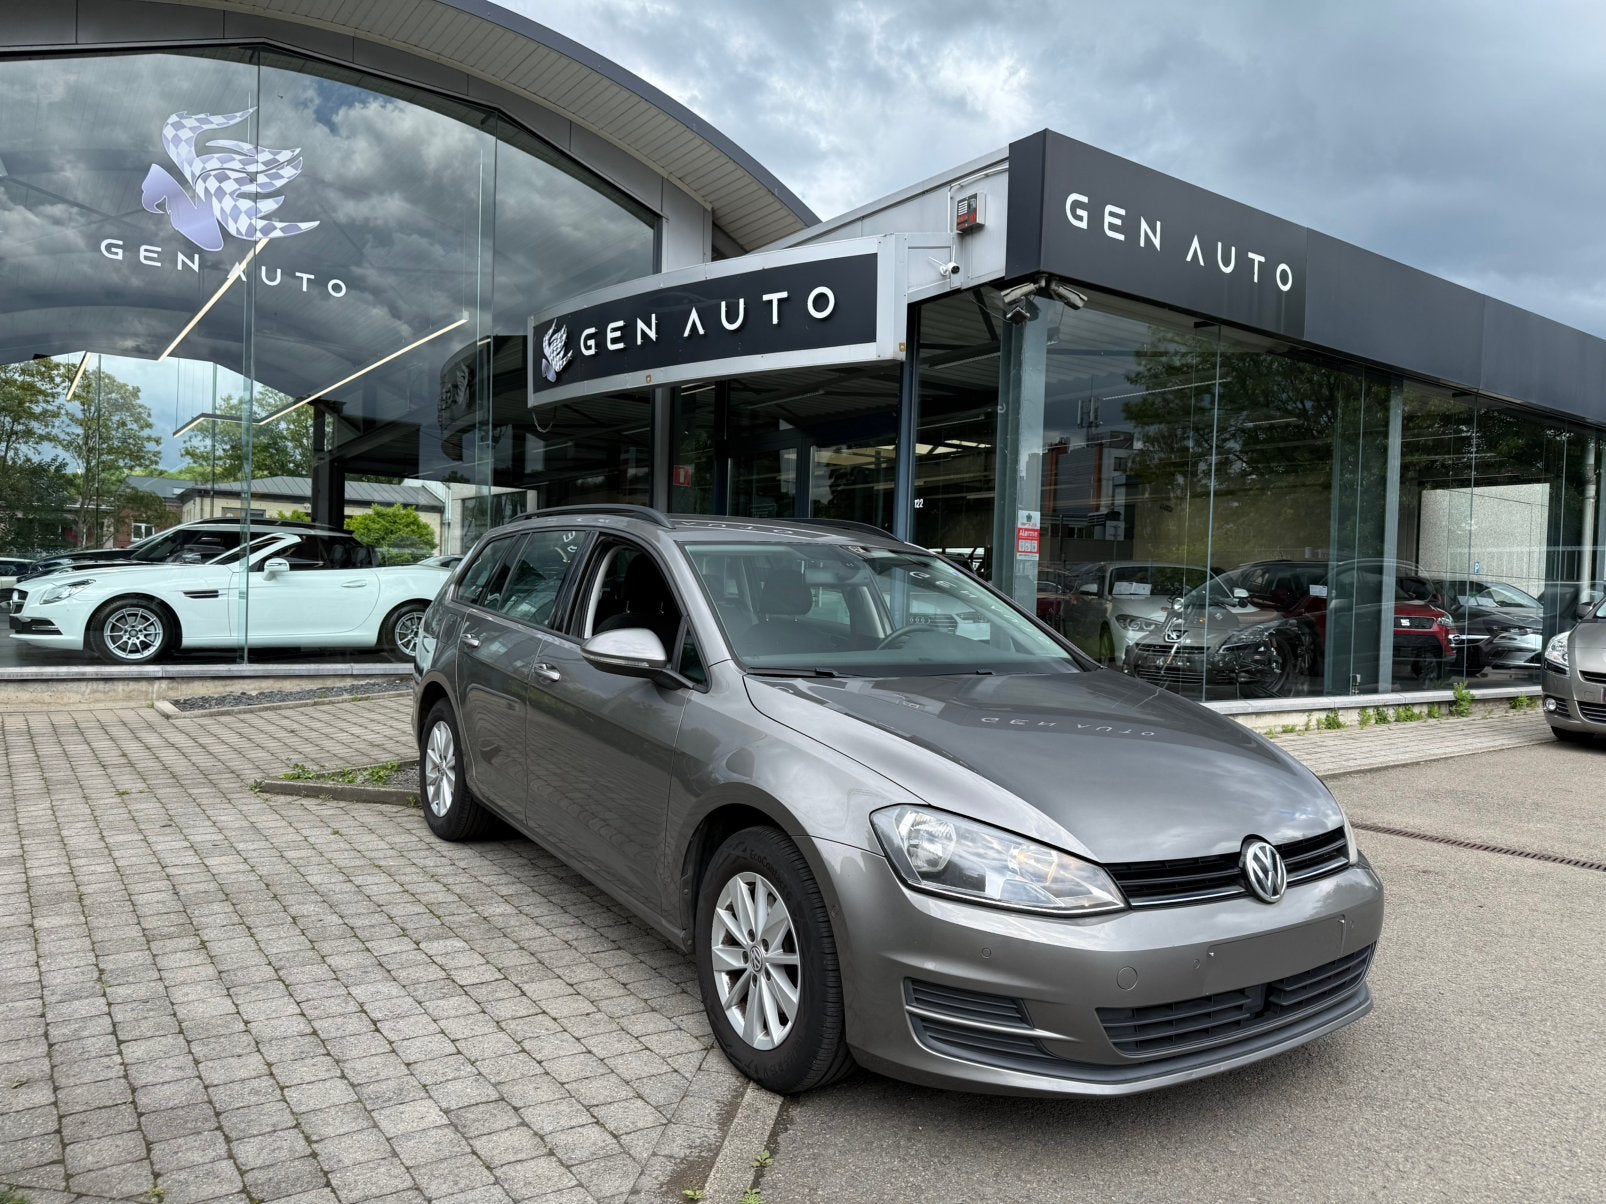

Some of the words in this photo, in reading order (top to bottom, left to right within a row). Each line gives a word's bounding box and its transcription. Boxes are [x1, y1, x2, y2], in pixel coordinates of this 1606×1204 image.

[100, 238, 200, 273] GEN
[227, 261, 347, 298] AUTO
[1065, 192, 1162, 252] GEN
[1185, 234, 1293, 292] AUTO
[580, 313, 657, 356] GEN
[683, 286, 835, 338] AUTO
